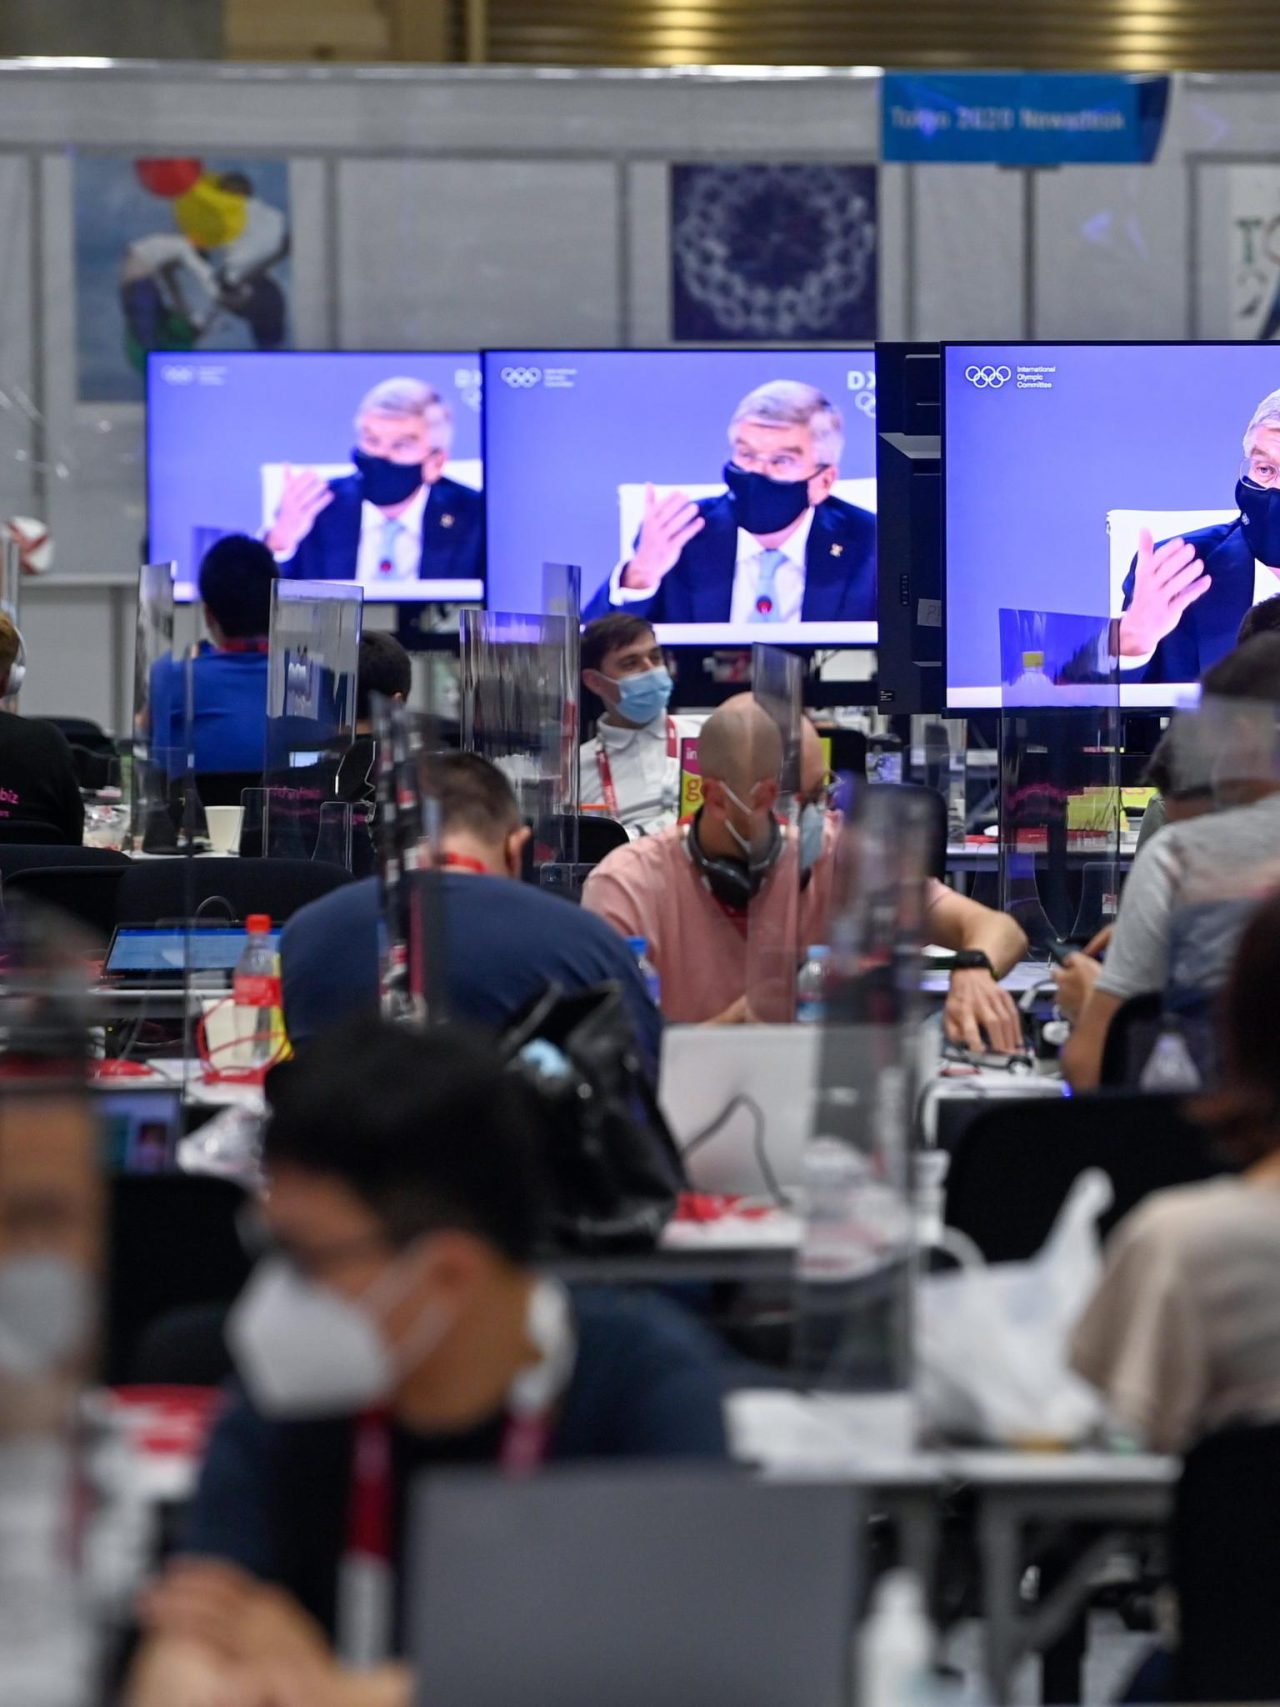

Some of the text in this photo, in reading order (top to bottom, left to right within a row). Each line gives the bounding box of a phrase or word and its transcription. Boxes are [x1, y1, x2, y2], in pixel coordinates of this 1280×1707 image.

[1017, 365, 1056, 373] International
[1017, 373, 1043, 382] Olympic
[1017, 381, 1052, 389] Committee
